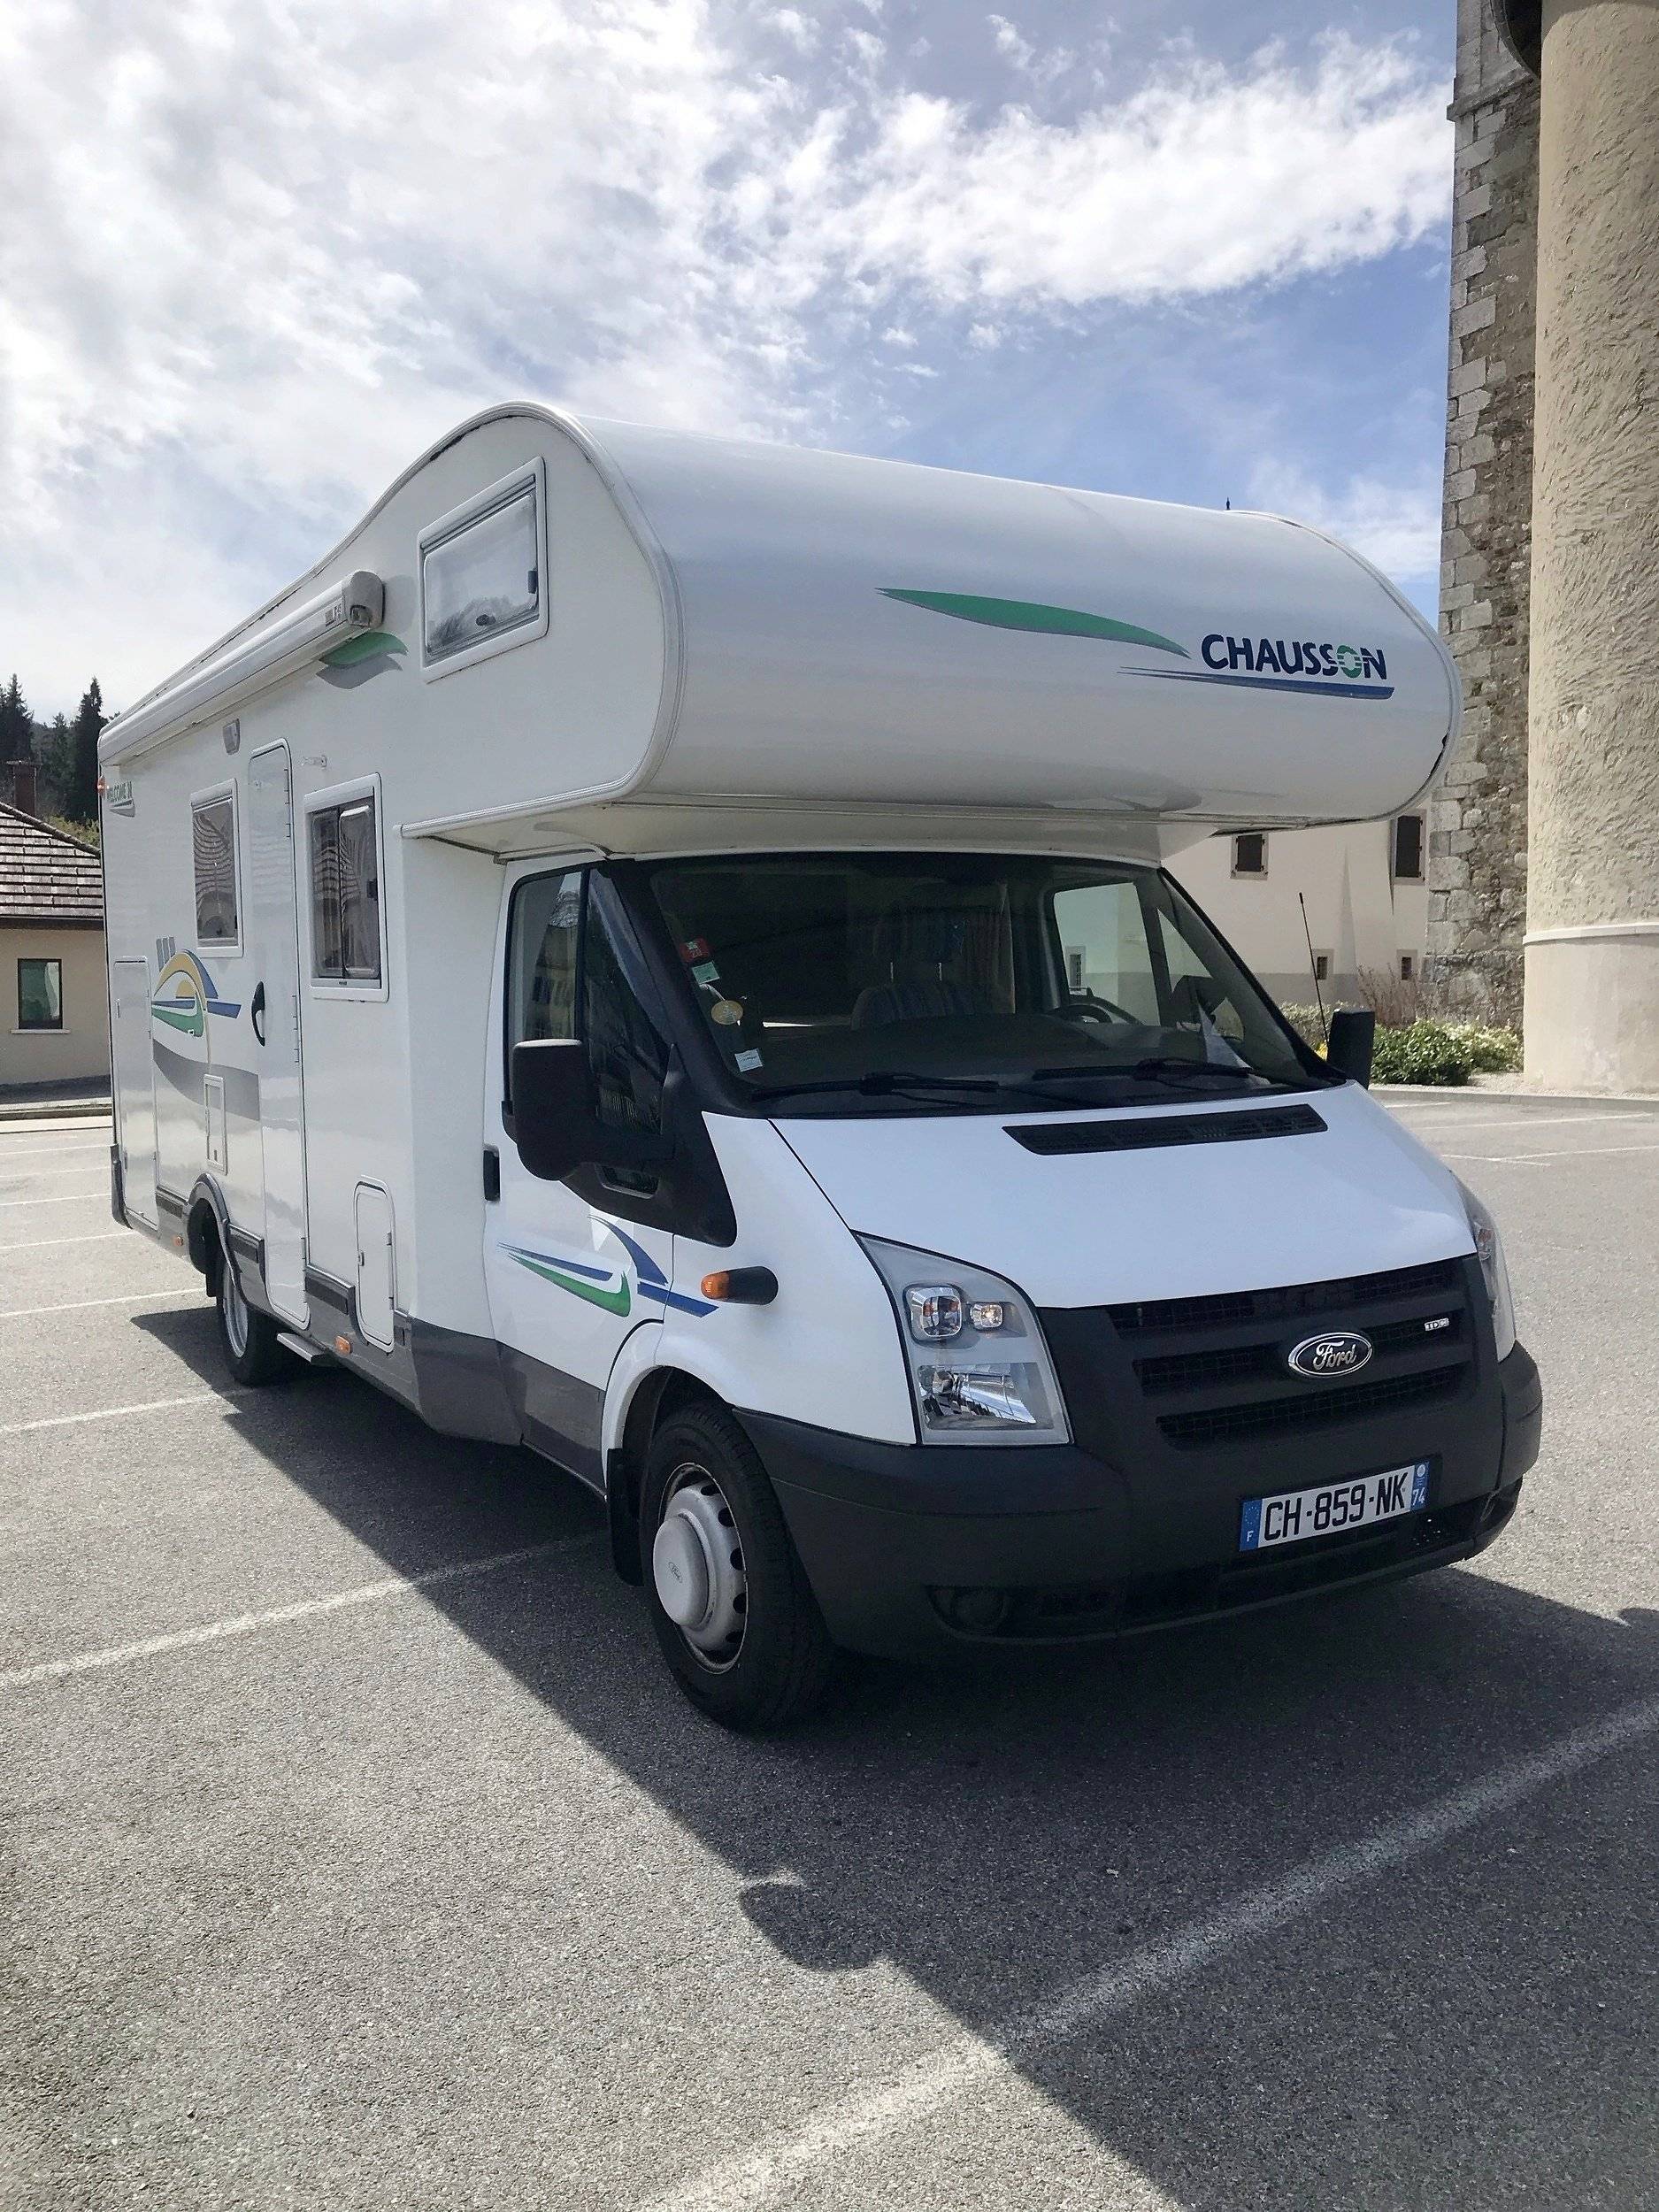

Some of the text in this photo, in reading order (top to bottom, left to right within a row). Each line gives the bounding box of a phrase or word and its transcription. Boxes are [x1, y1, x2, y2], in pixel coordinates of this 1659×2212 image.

[1201, 633, 1387, 680] CHAUSSON
[1312, 1340, 1358, 1371] Ford
[1263, 1471, 1409, 1541] CH-859-NK
[1411, 1486, 1426, 1507] 74
[1246, 1529, 1255, 1542] F
